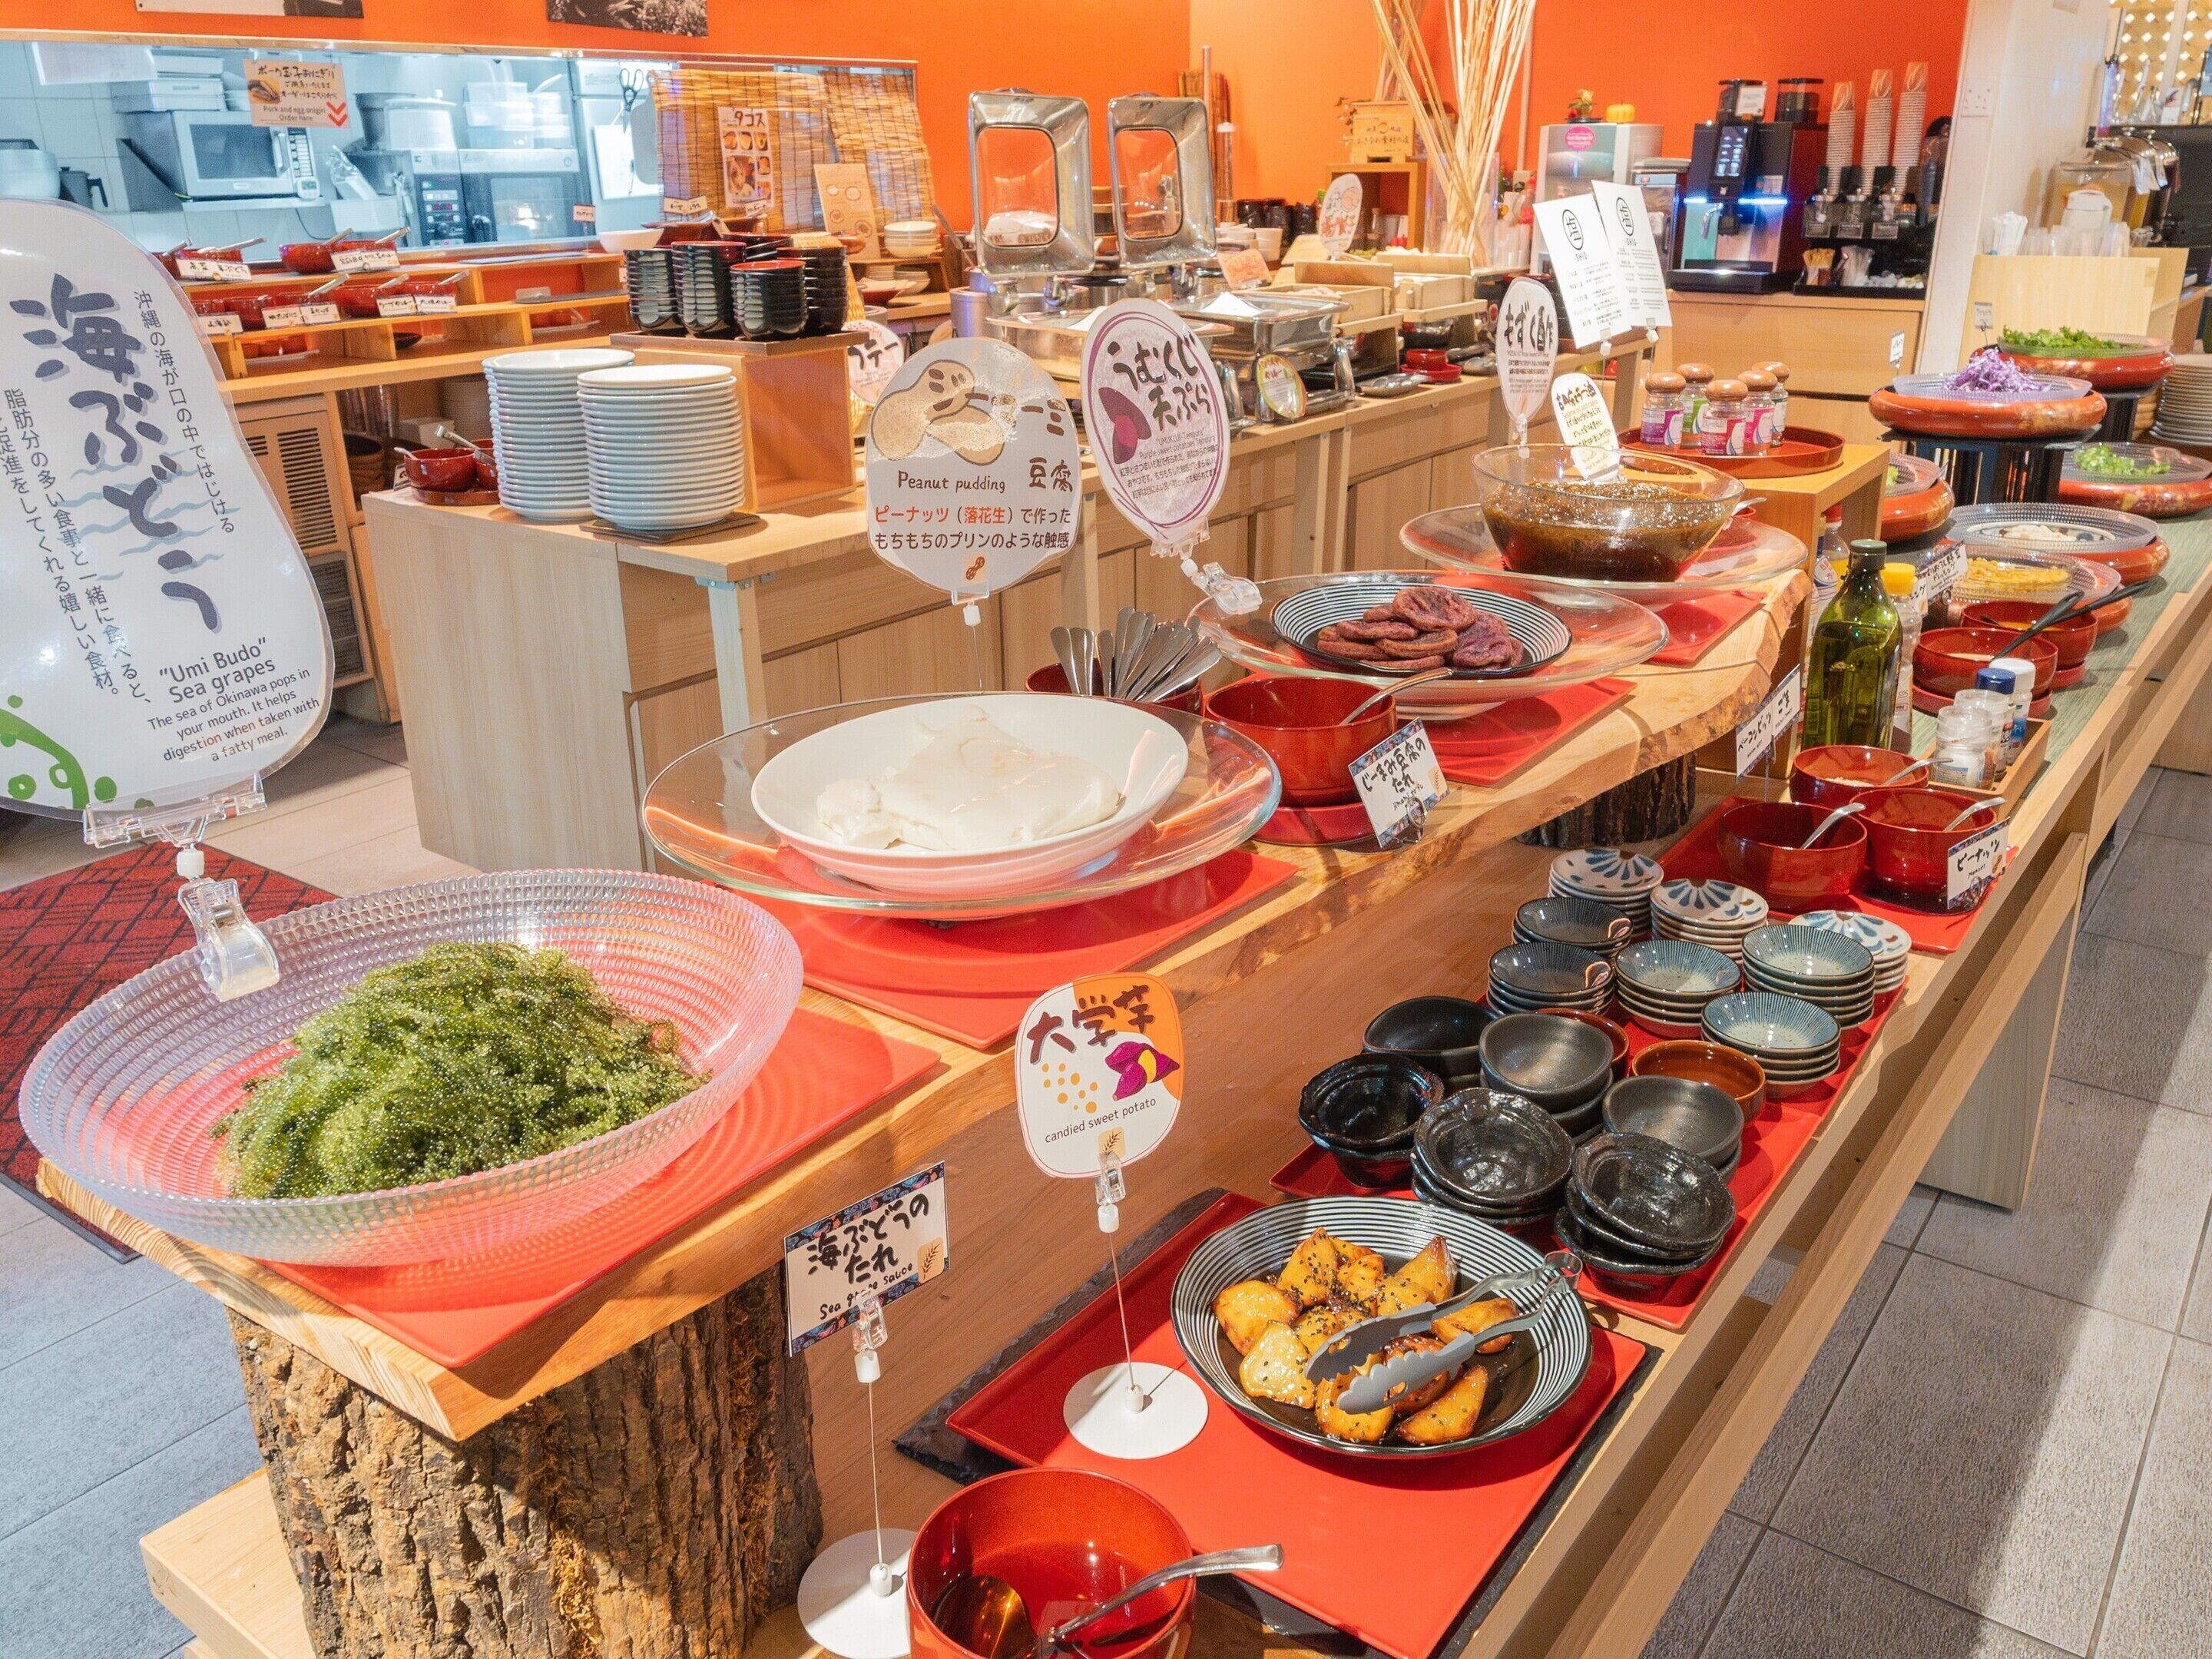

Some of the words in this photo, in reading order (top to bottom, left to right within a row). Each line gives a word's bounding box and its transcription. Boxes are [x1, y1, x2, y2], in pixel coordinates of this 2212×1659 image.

[734, 111, 765, 127] タコス
[1108, 331, 1200, 392] うむくじ
[134, 291, 235, 533] 沖縄の海が口の中ではじける
[1147, 382, 1212, 432] 天ぷら
[10, 273, 220, 631] 海ぶどう
[1029, 456, 1073, 492] 豆腐
[1157, 446, 1172, 455] sweet
[897, 470, 949, 490] Peanut
[955, 475, 1005, 494] pudding
[875, 505, 1071, 525] ピーナッツ（落花生）で作った
[5, 388, 151, 704] 脂肪分の多い食事と一緒に食べると、
[875, 531, 1070, 550] もちもちのプリンのような触感
[147, 715, 173, 730] The
[176, 708, 197, 722] sea
[200, 700, 213, 714] of
[216, 684, 267, 707] Okinawa
[270, 674, 296, 690] pops
[297, 668, 310, 679] in
[169, 682, 207, 703] Sea
[212, 660, 276, 694] grapes
[163, 733, 222, 760] digestion
[224, 721, 256, 739] when
[258, 709, 292, 727] taken
[293, 697, 320, 714] with
[177, 722, 204, 741] your
[207, 707, 250, 727] mouth.
[252, 701, 263, 712] It
[265, 689, 296, 707] helps
[212, 752, 220, 761] a
[221, 739, 254, 758] fatty
[257, 727, 288, 745] meal.
[1362, 737, 1426, 792] じーまみ豆腐の
[1392, 771, 1414, 793] たれ
[1957, 839, 2000, 872] ピーナッツ
[1027, 985, 1154, 1065] 大学芋
[1045, 1121, 1085, 1143] candied
[1088, 1110, 1119, 1128] sweet
[1122, 1098, 1156, 1118] potato
[806, 1193, 929, 1275] 海ぶどうの
[845, 1243, 898, 1284] たれ
[820, 1303, 841, 1320] Sea
[846, 1281, 878, 1307] gre
[883, 1263, 912, 1285] sauce
